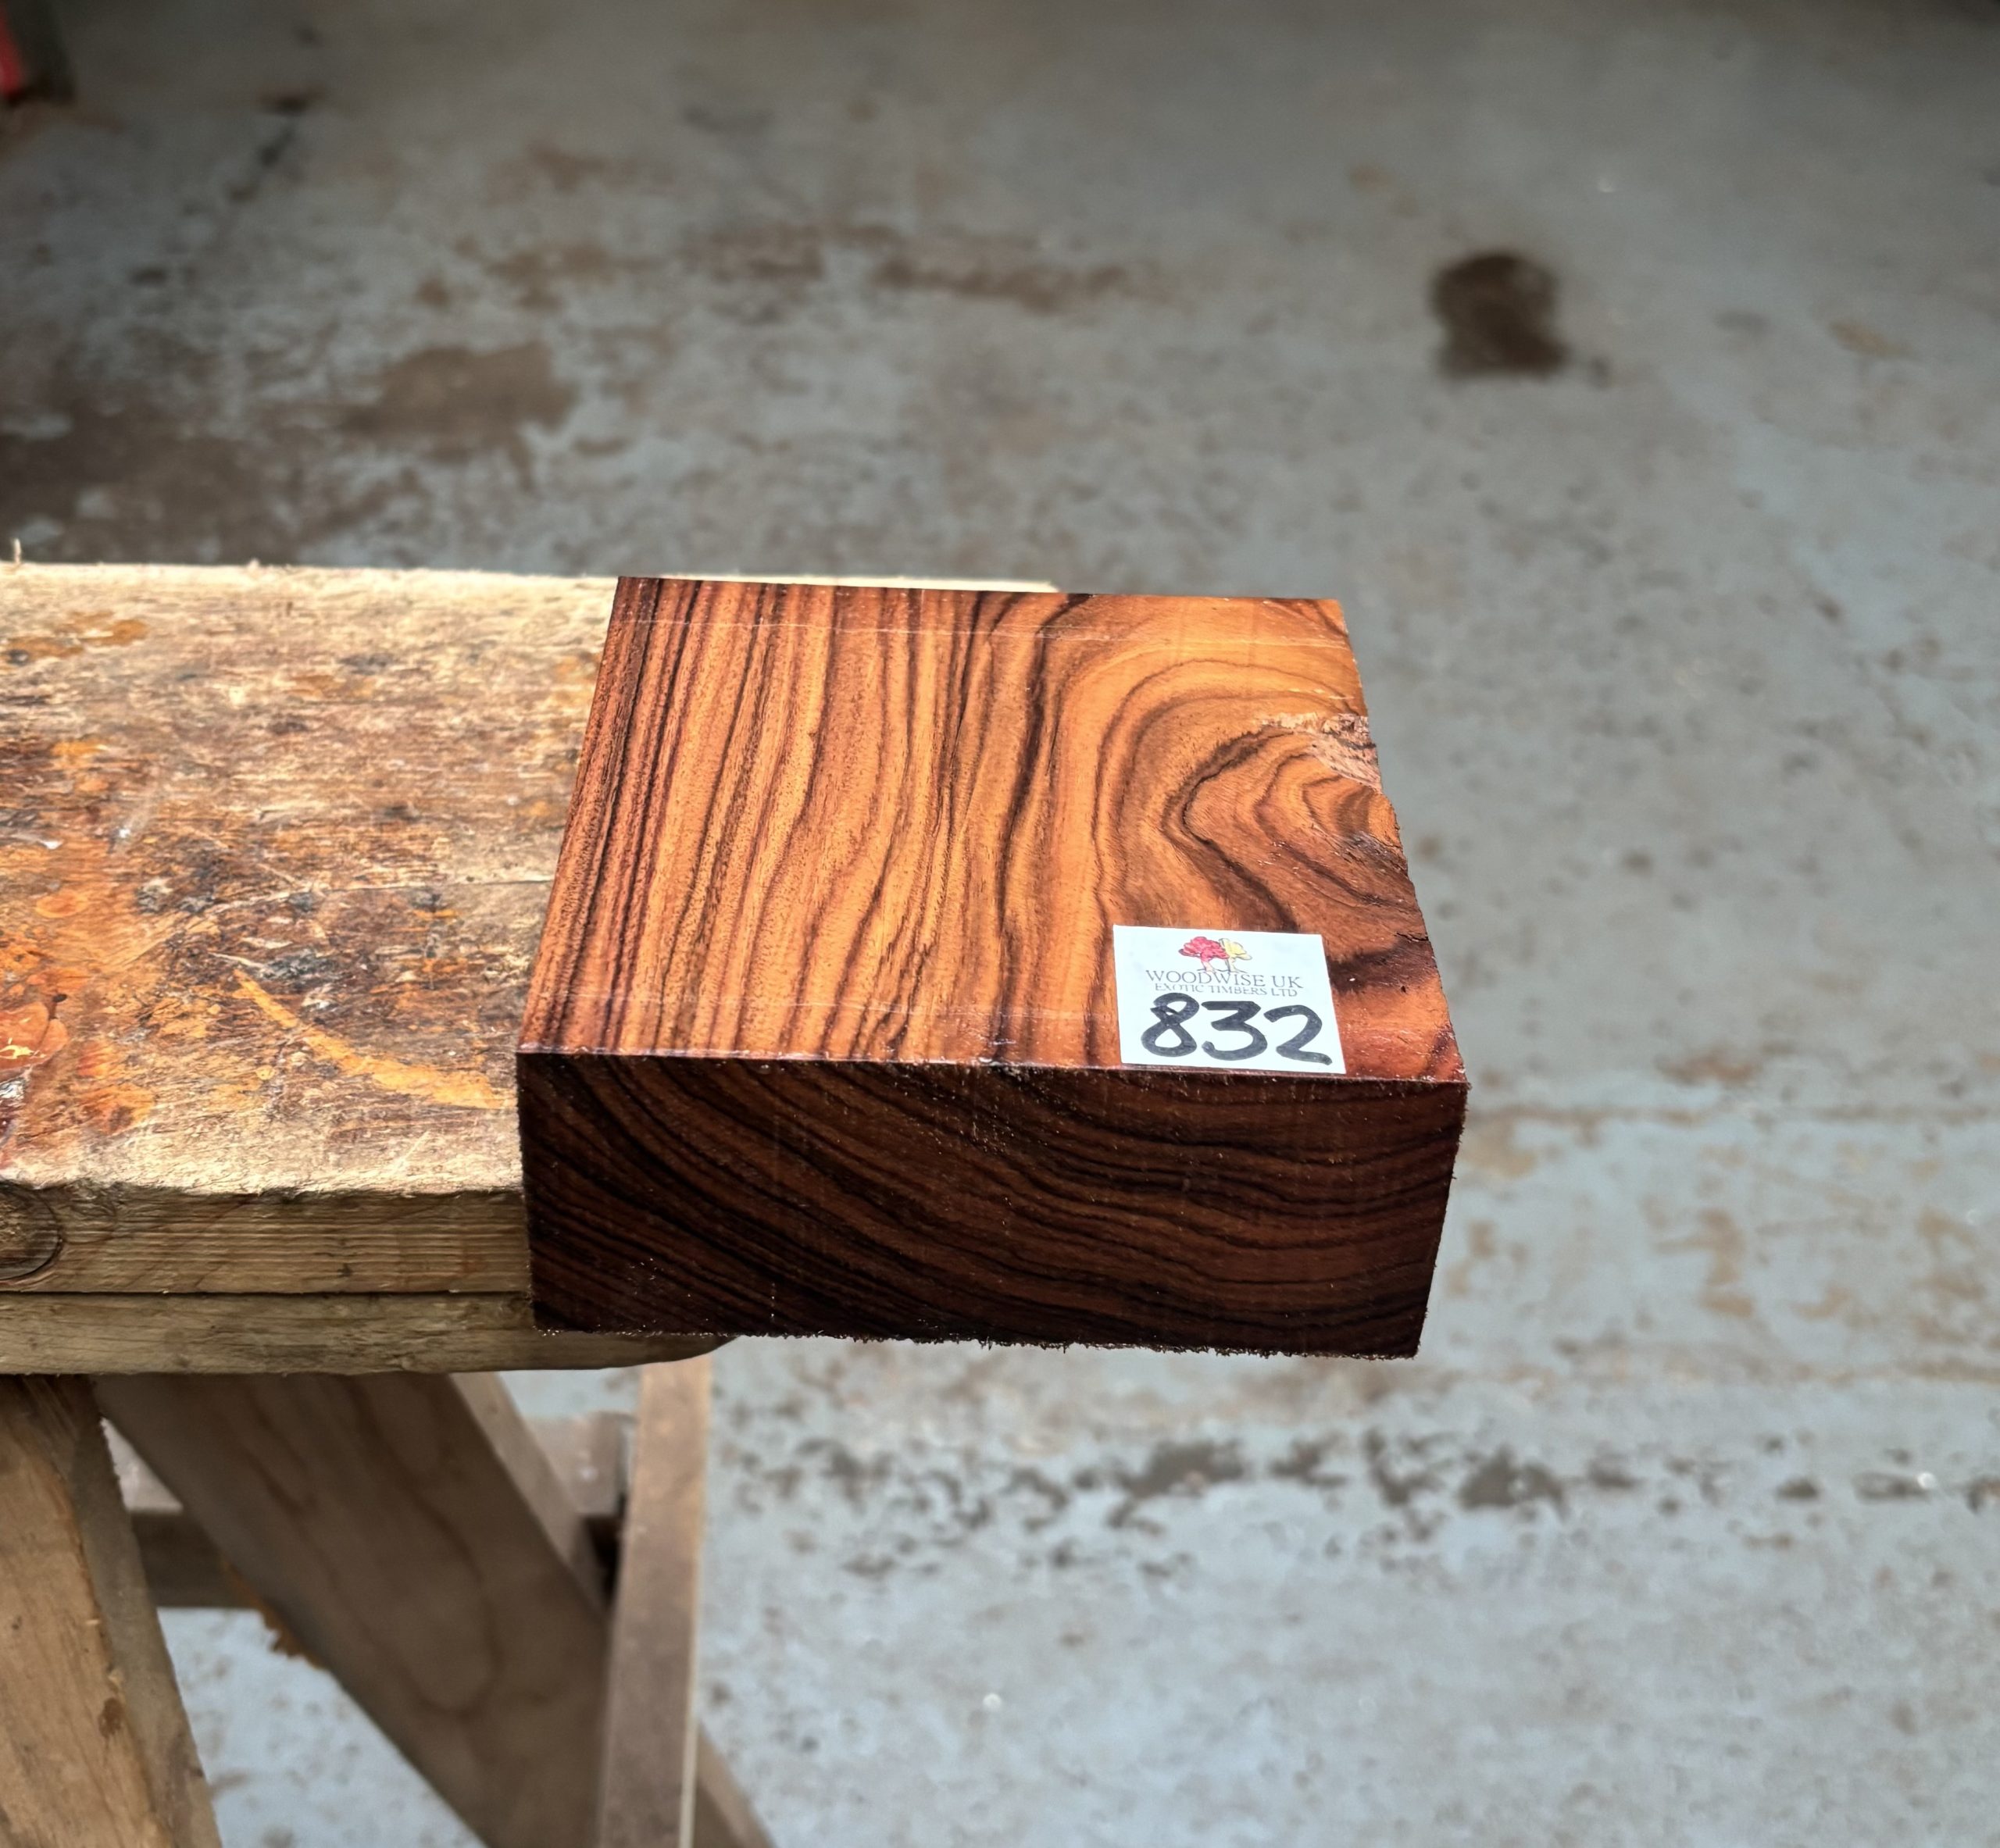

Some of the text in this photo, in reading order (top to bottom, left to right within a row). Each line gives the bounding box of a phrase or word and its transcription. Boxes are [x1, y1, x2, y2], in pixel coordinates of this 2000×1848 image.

[1145, 969, 1304, 989] WOODWISE UK
[1155, 983, 1298, 997] EXOTIC TIMBERS LTD
[1141, 992, 1333, 1066] 832
